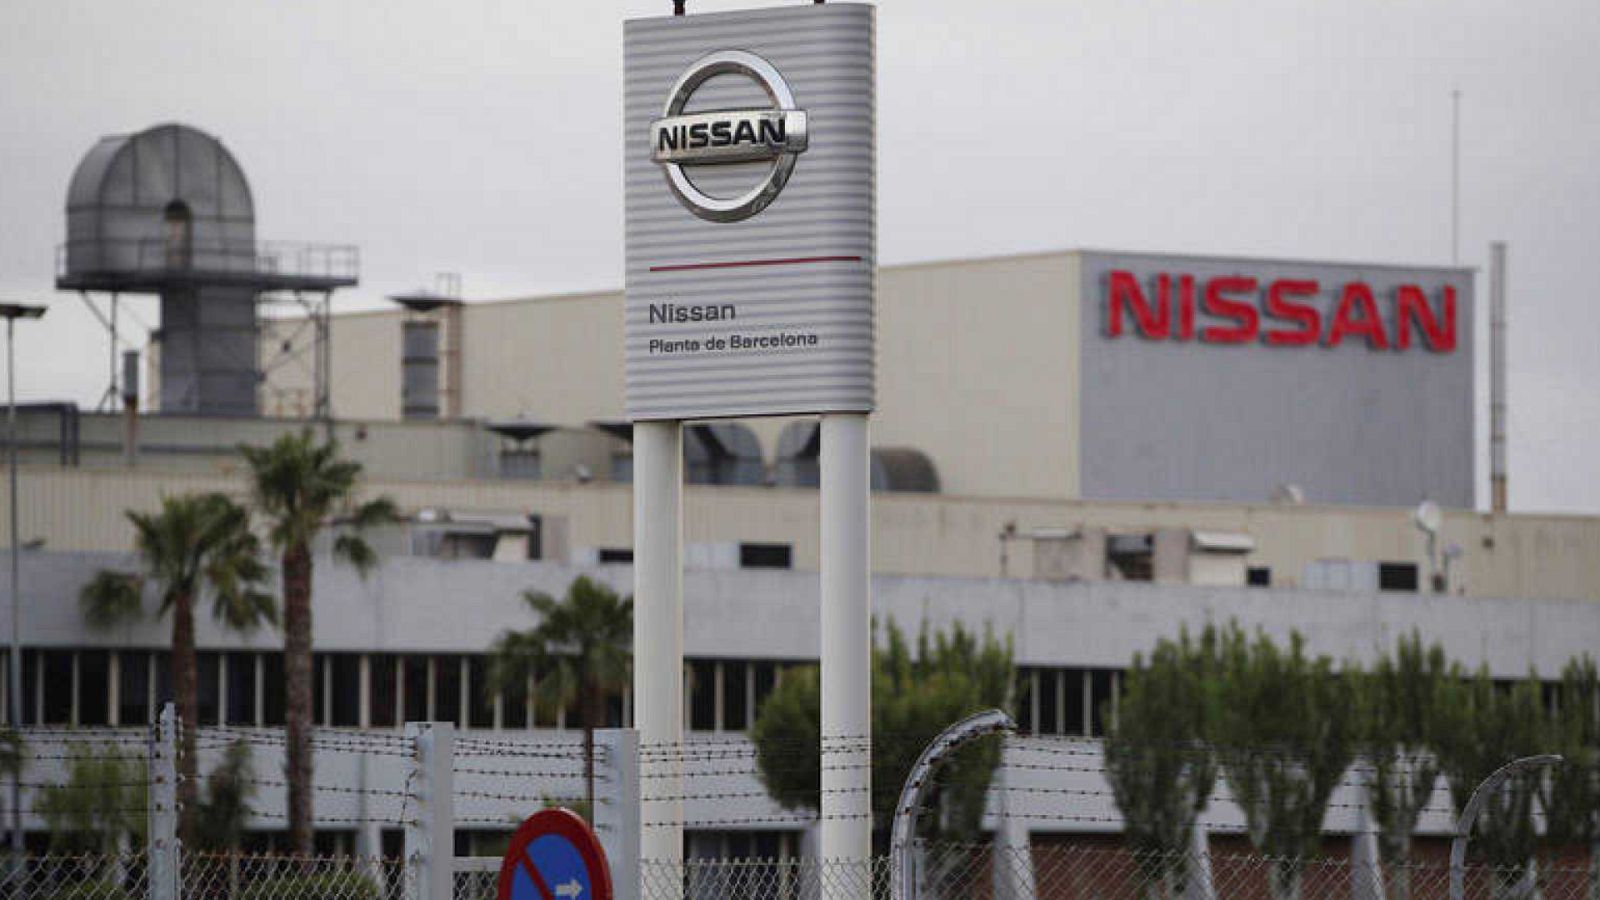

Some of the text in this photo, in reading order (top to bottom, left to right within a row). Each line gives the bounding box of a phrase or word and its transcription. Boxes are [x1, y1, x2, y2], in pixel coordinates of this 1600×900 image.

[659, 118, 786, 151] NISSAN
[649, 303, 736, 324] Nissan
[1107, 269, 1457, 353] NISSAN
[649, 332, 818, 354] Planta de Barcelona
